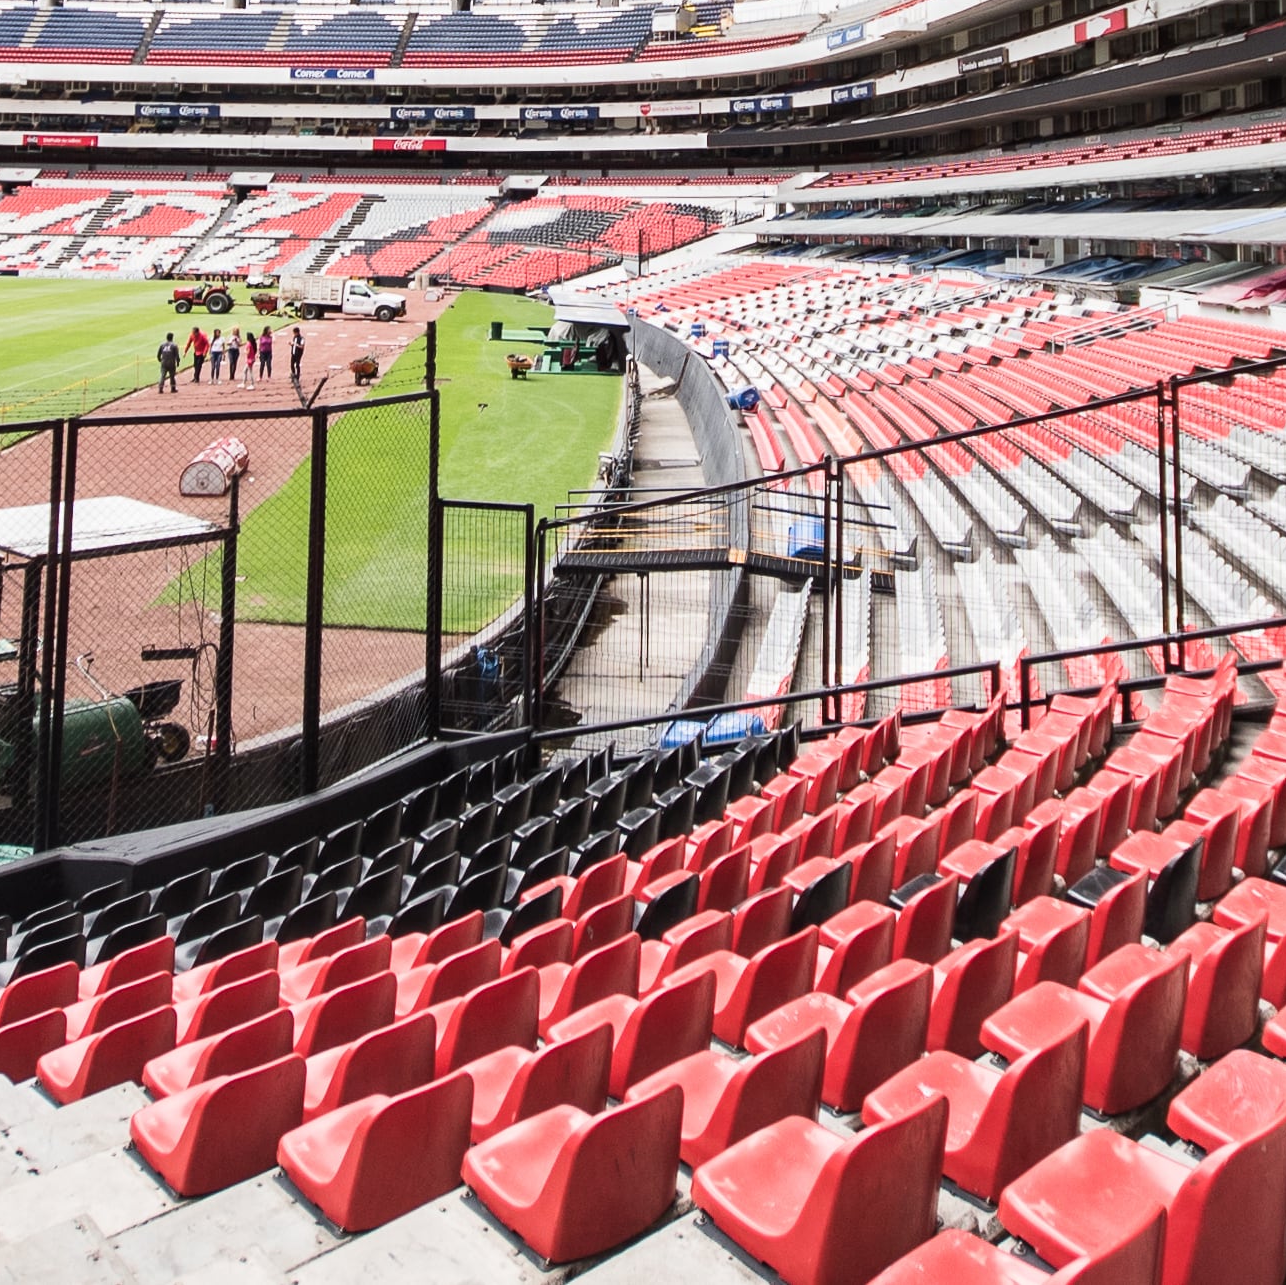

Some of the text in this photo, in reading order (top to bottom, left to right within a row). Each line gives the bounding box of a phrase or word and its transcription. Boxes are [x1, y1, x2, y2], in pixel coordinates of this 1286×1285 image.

[295, 69, 370, 78] Comex Comex
[140, 105, 209, 115] Corona Corona
[396, 108, 464, 118] Corona Corona
